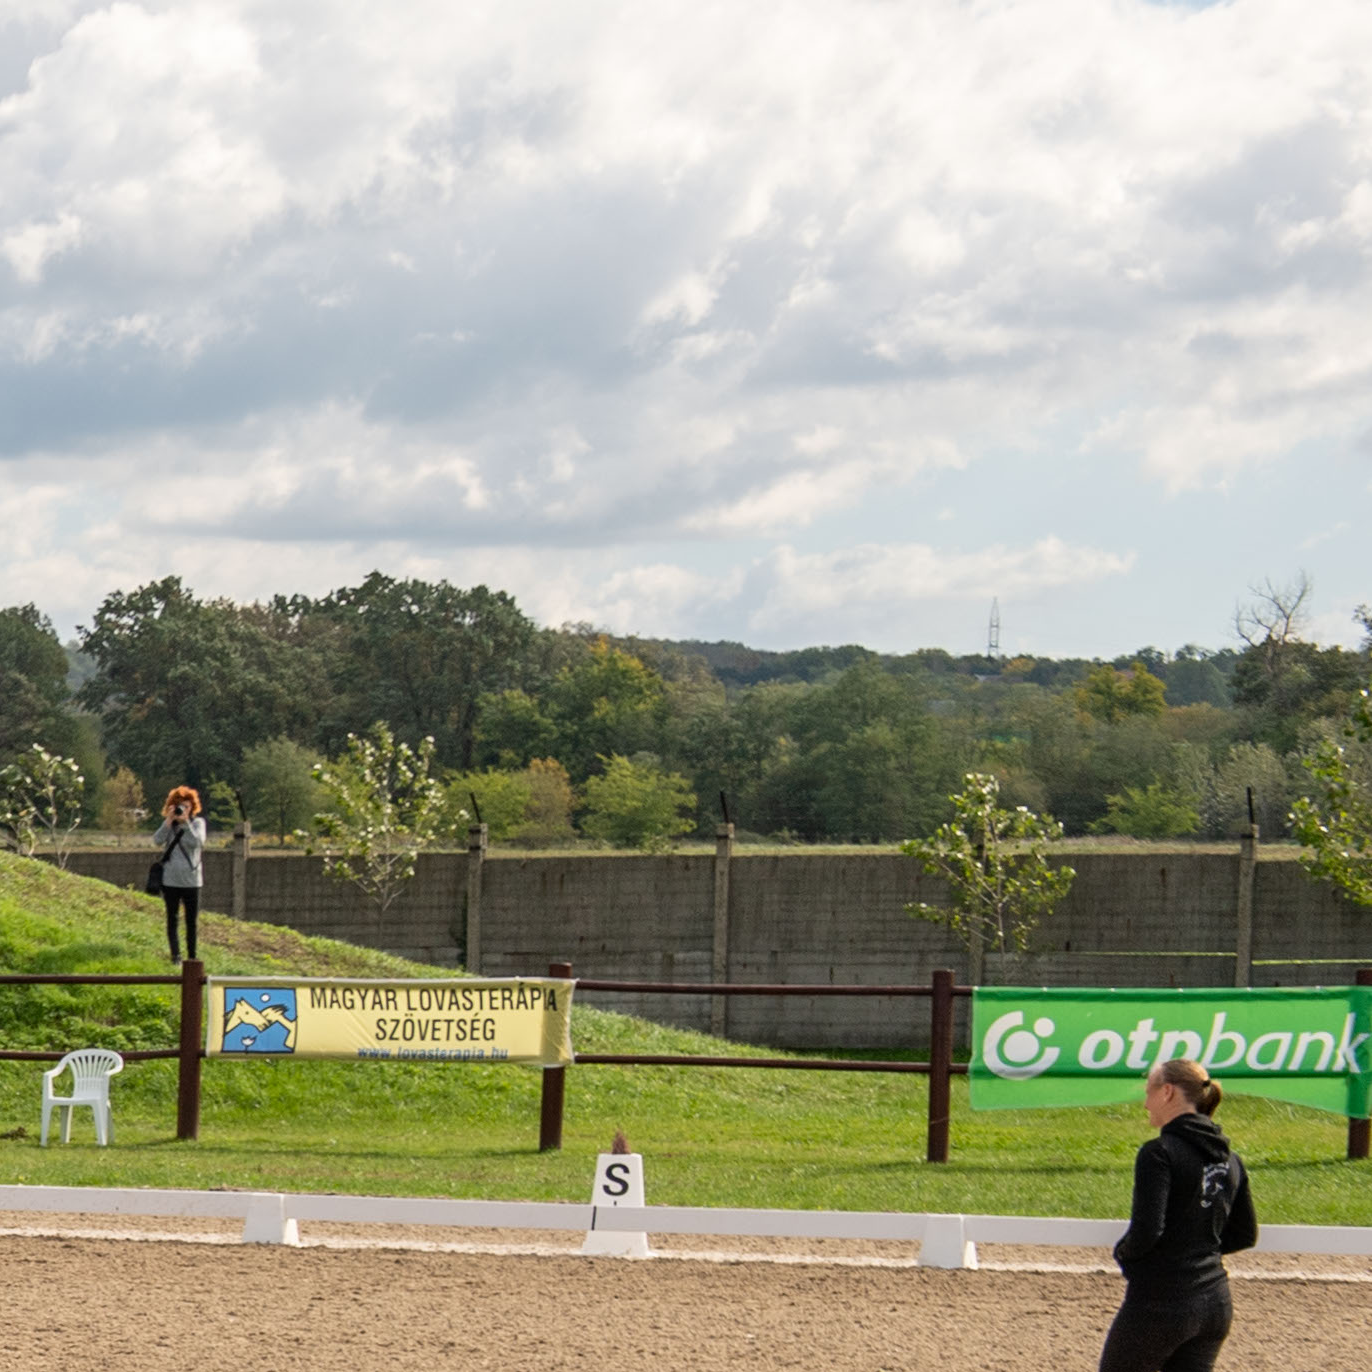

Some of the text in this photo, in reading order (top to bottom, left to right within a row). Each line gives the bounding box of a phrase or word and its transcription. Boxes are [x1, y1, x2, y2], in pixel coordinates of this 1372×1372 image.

[310, 982, 558, 1012] MAGYAR LOVASTERÁPIA
[375, 1012, 496, 1041] SZÖVETSÉG
[603, 1163, 630, 1196] S
